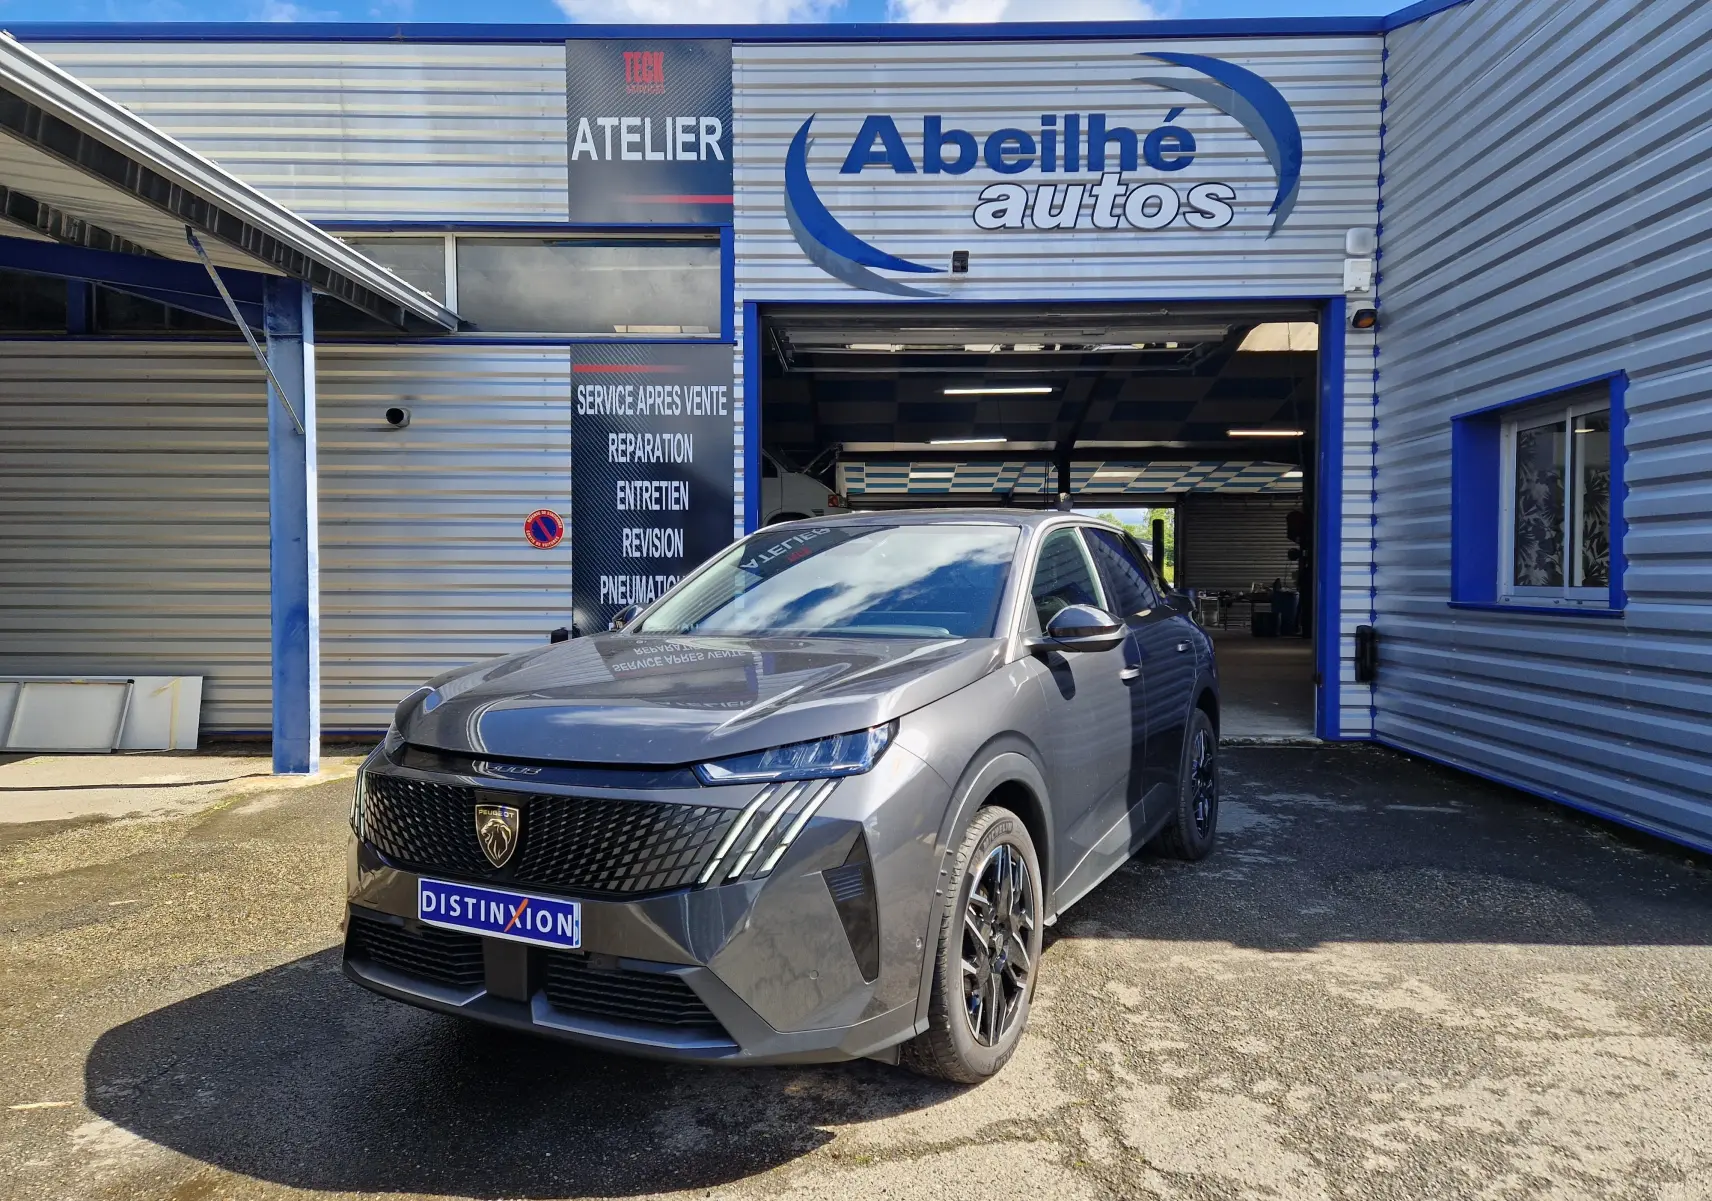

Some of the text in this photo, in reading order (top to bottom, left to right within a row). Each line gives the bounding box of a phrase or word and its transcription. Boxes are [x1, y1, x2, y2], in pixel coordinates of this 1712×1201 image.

[571, 116, 725, 161] ATELIER
[839, 106, 1197, 174] Abeilhé
[972, 171, 1236, 230] autos
[577, 385, 727, 416] SERVICE APRES VENTE
[608, 433, 693, 463] REPARATION
[616, 481, 689, 511] ENTRETIEN
[622, 528, 684, 558] REVISION
[600, 575, 686, 605] PNEUMATI
[478, 810, 515, 819] PEUGEOT
[422, 890, 573, 937] DISTINXION
